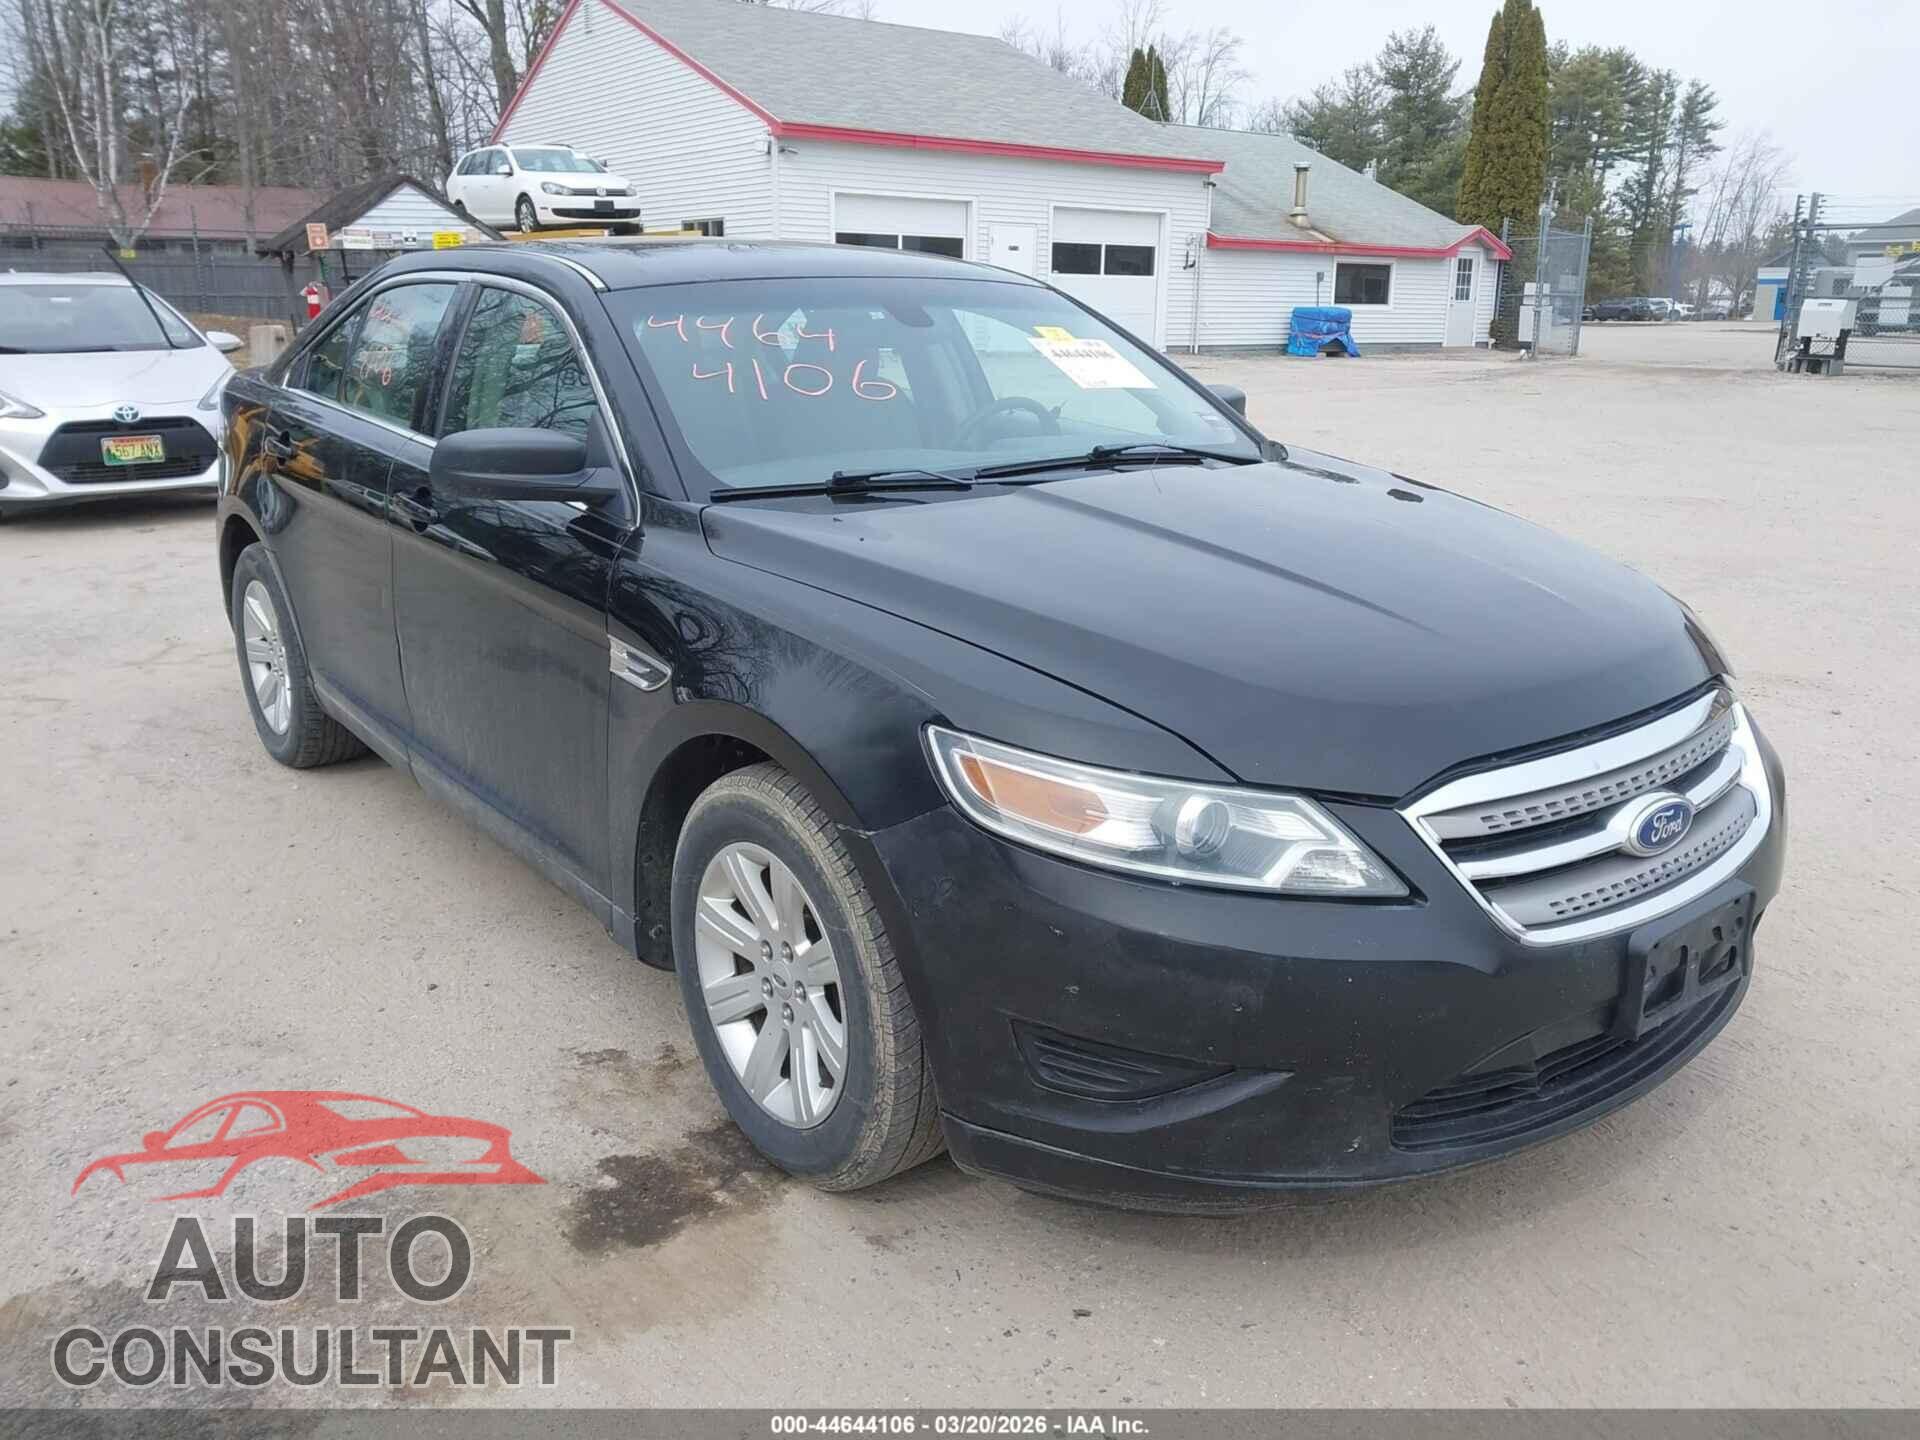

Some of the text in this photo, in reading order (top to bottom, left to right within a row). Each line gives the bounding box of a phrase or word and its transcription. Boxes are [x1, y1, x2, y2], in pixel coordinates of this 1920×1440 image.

[647, 312, 836, 353] 4464
[692, 358, 897, 401] 4106
[1650, 808, 1684, 843] Ford
